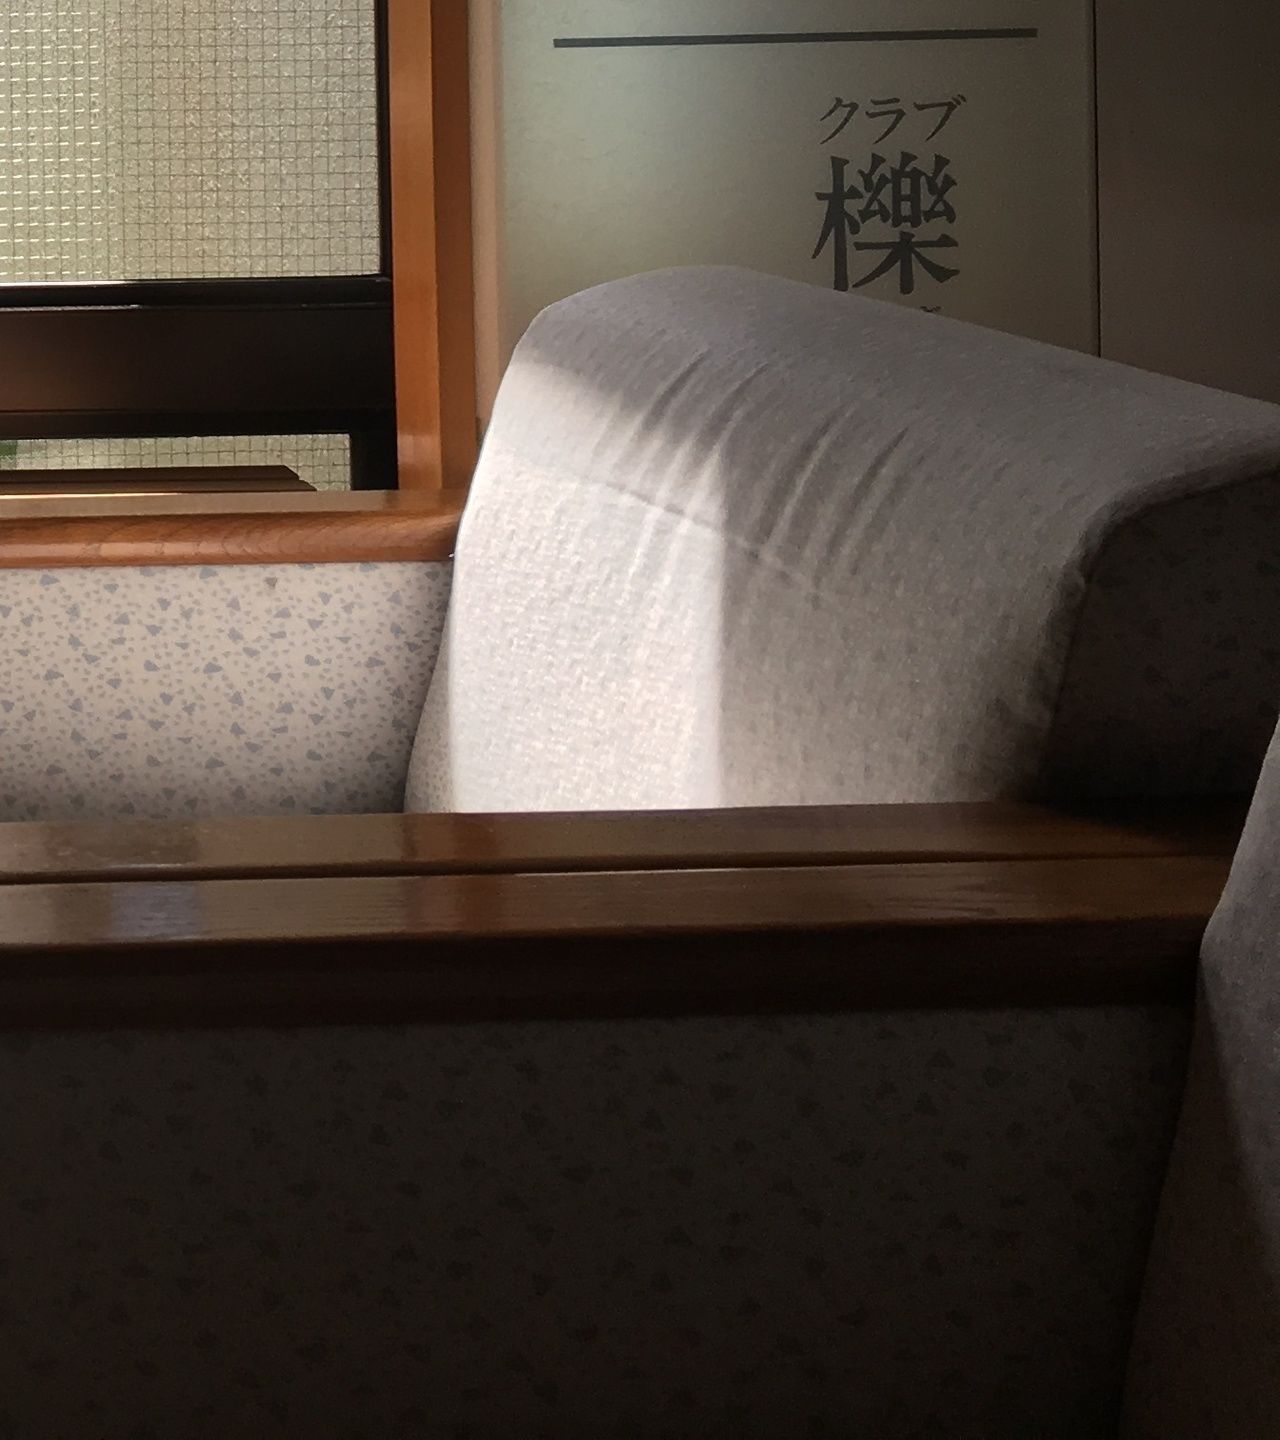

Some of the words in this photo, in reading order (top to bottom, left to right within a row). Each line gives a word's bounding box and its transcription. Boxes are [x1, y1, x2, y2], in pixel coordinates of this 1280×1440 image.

[819, 93, 968, 146] クラブ
[810, 150, 961, 297] 櫟
